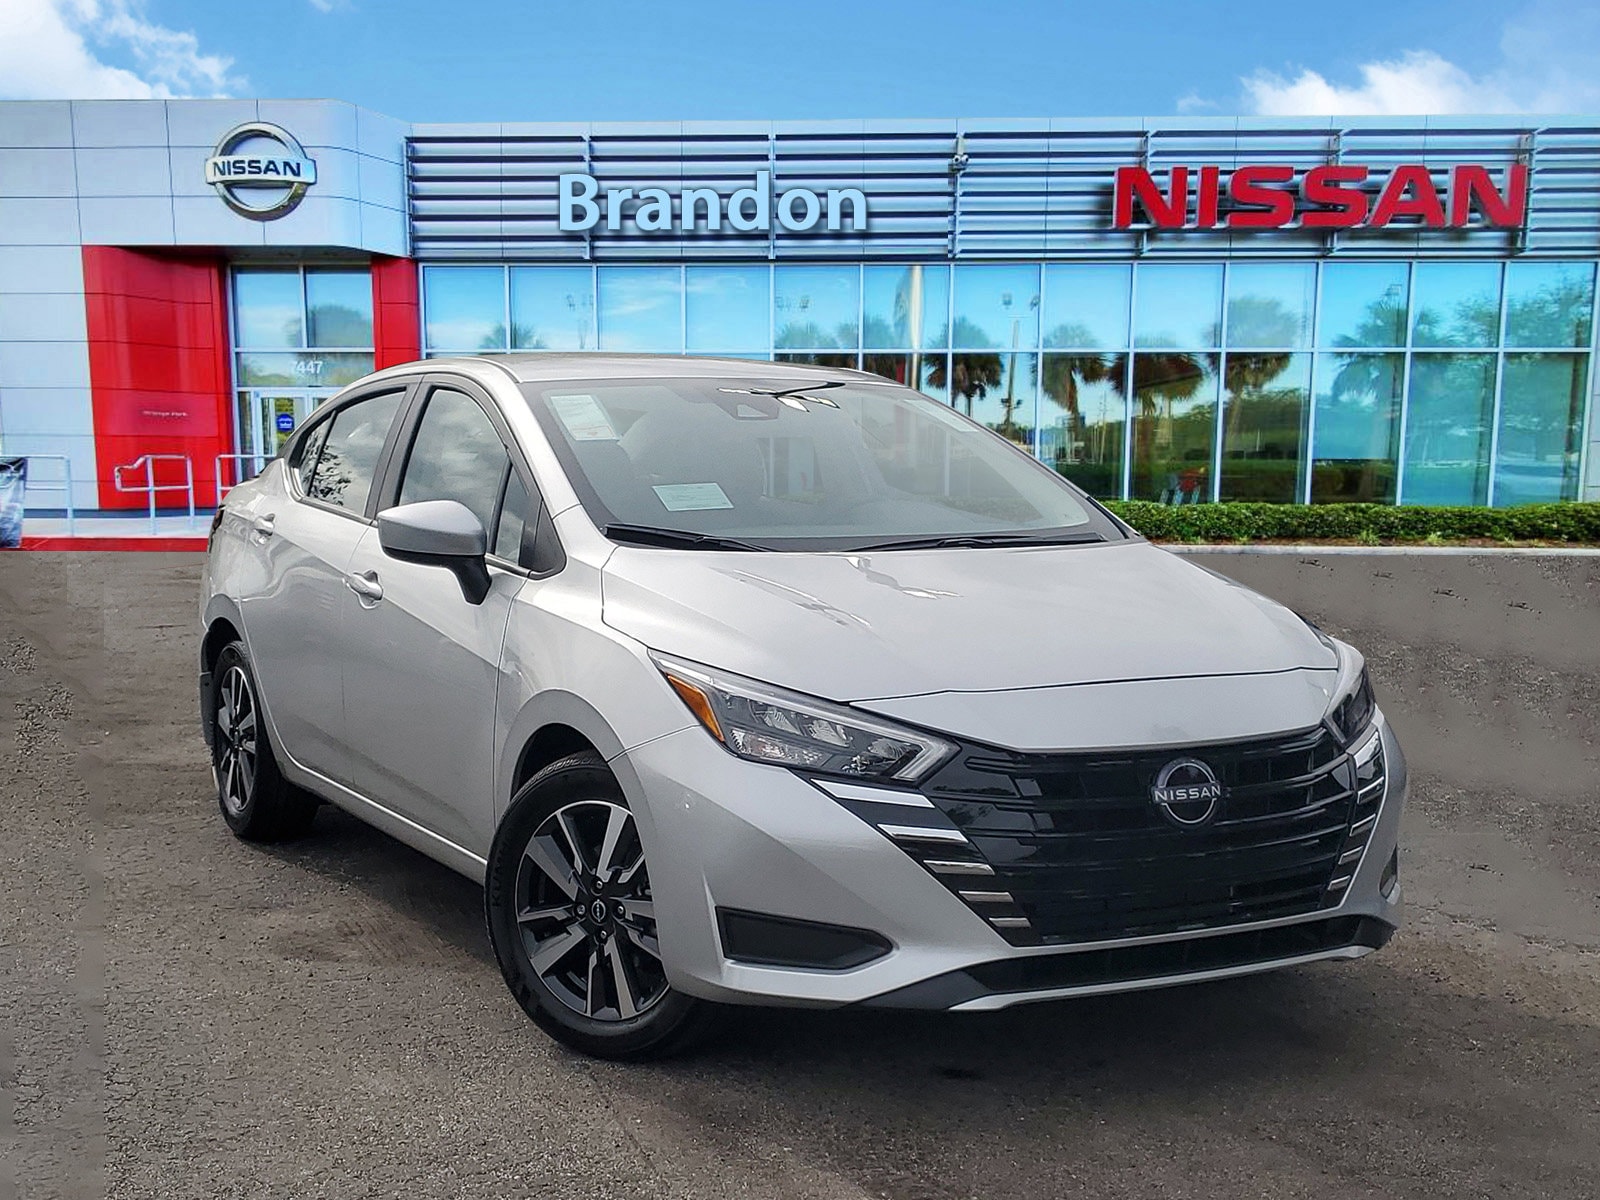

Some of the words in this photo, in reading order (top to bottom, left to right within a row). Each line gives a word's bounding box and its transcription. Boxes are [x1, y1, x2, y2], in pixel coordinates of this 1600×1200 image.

[212, 159, 301, 178] NISSAN
[1113, 165, 1527, 229] NISSAN
[1154, 785, 1220, 801] NISSAN
